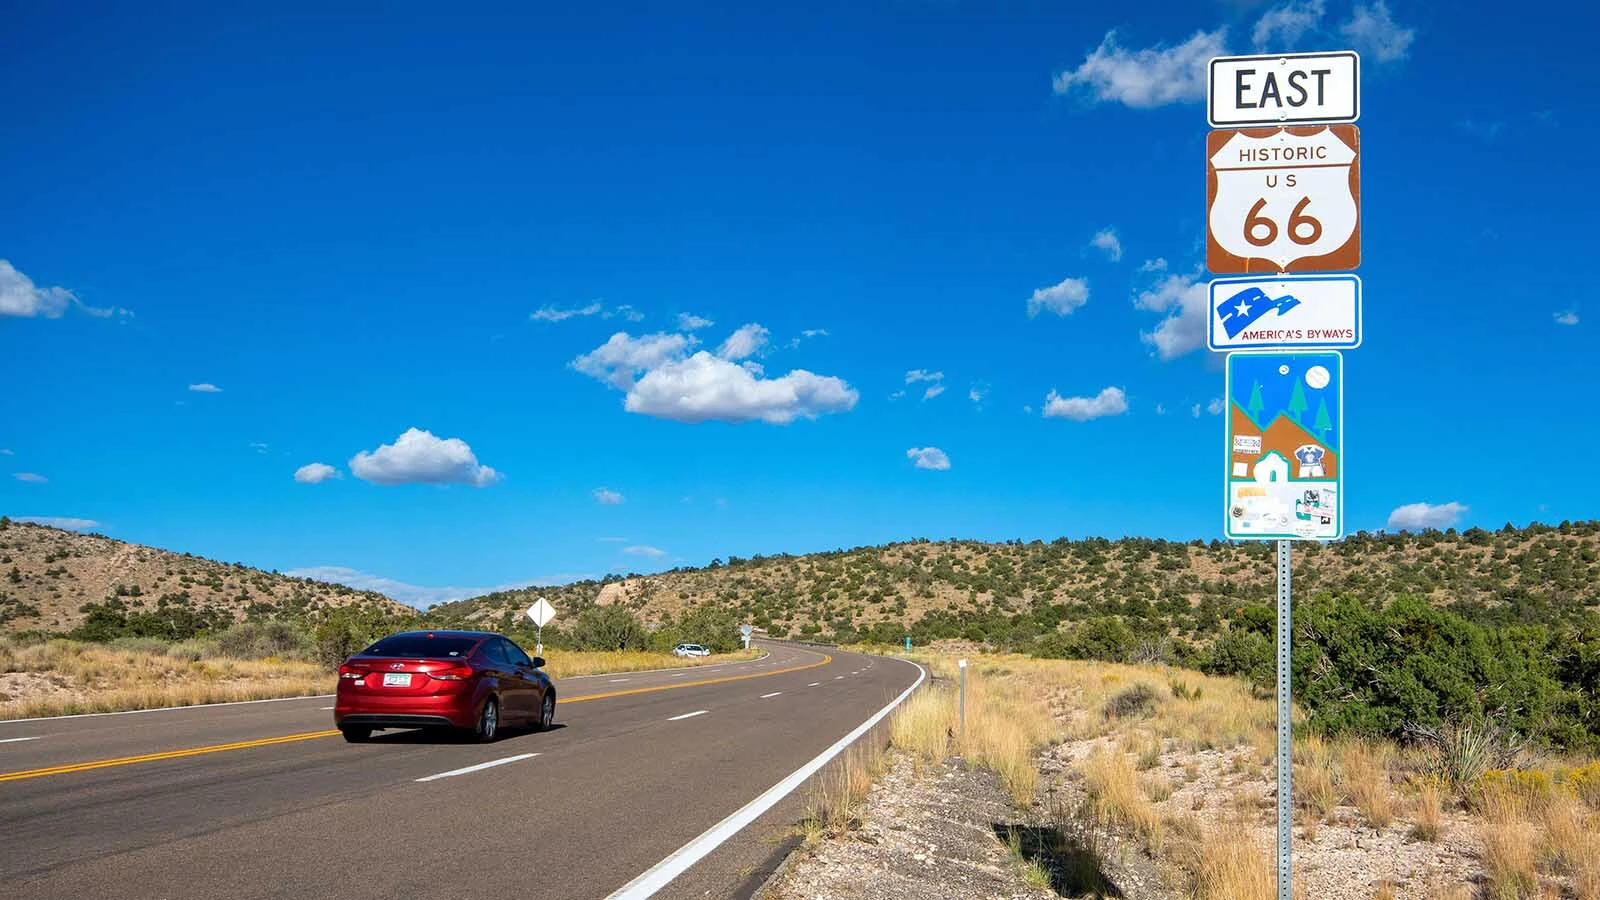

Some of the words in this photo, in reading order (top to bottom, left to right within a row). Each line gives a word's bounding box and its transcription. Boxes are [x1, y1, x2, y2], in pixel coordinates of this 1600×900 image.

[1235, 69, 1331, 109] EAST
[1239, 146, 1327, 162] HISTORIC
[1243, 196, 1322, 247] 66
[1241, 330, 1303, 340] AMERICA'S
[1307, 329, 1353, 339] BYWAYS
